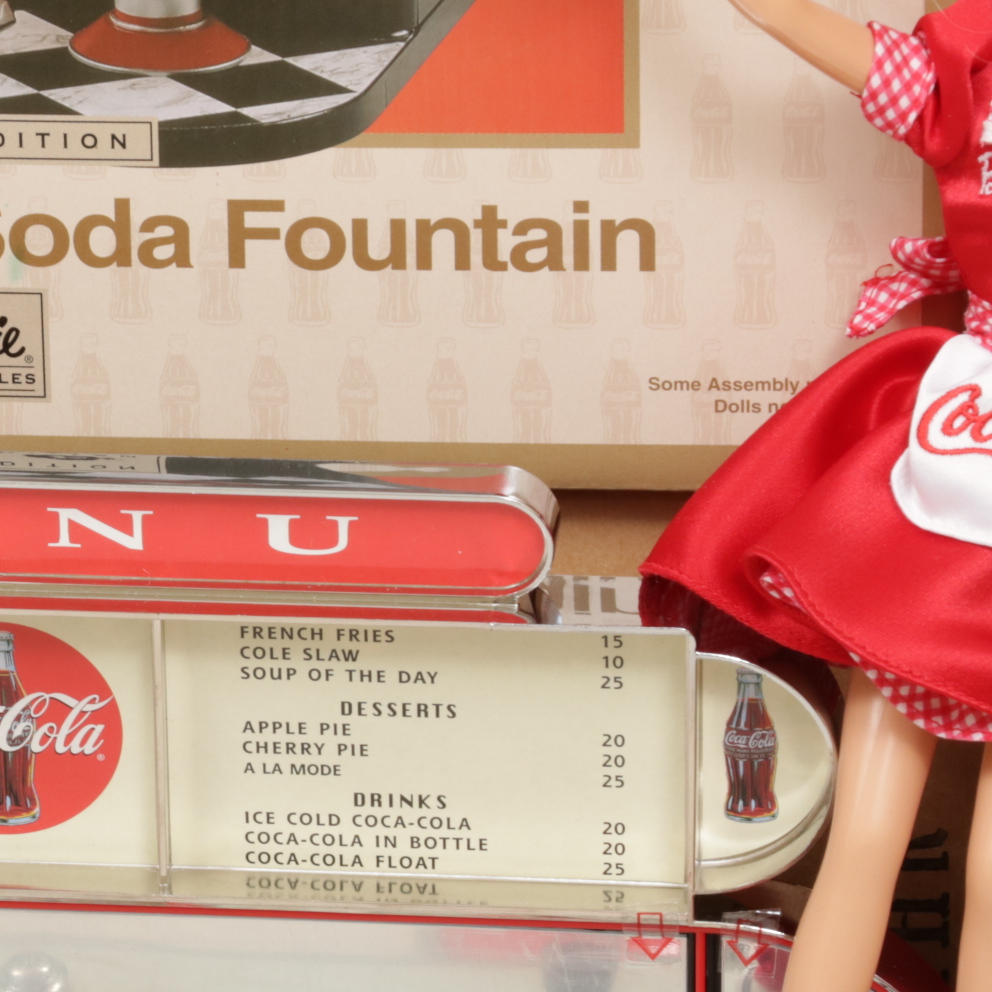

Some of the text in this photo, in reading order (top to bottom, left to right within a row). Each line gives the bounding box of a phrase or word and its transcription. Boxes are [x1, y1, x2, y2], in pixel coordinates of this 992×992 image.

[226, 199, 657, 273] Fountain
[648, 376, 702, 391] Some
[707, 377, 800, 395] Assembly
[714, 398, 762, 413] Dolls
[240, 626, 623, 648] FRENCH FRIES 15
[240, 646, 624, 669] COLE SLAW 10
[241, 667, 623, 689] SOUP OF THE DAY 25
[341, 701, 456, 718] DESSERTS
[243, 721, 625, 747] APPLE PIE 20
[724, 729, 775, 749] Coca-Cola
[243, 741, 625, 768] CHERRY PIE 20
[244, 762, 624, 788] A LA MODE 25
[354, 792, 446, 809] DRINKS
[245, 811, 625, 835] ICE COLD COCA-COLA 20
[245, 831, 625, 855] COCA-COLA IN BOTTLE 20
[245, 851, 625, 876] COCA-COLA FLOAT 25
